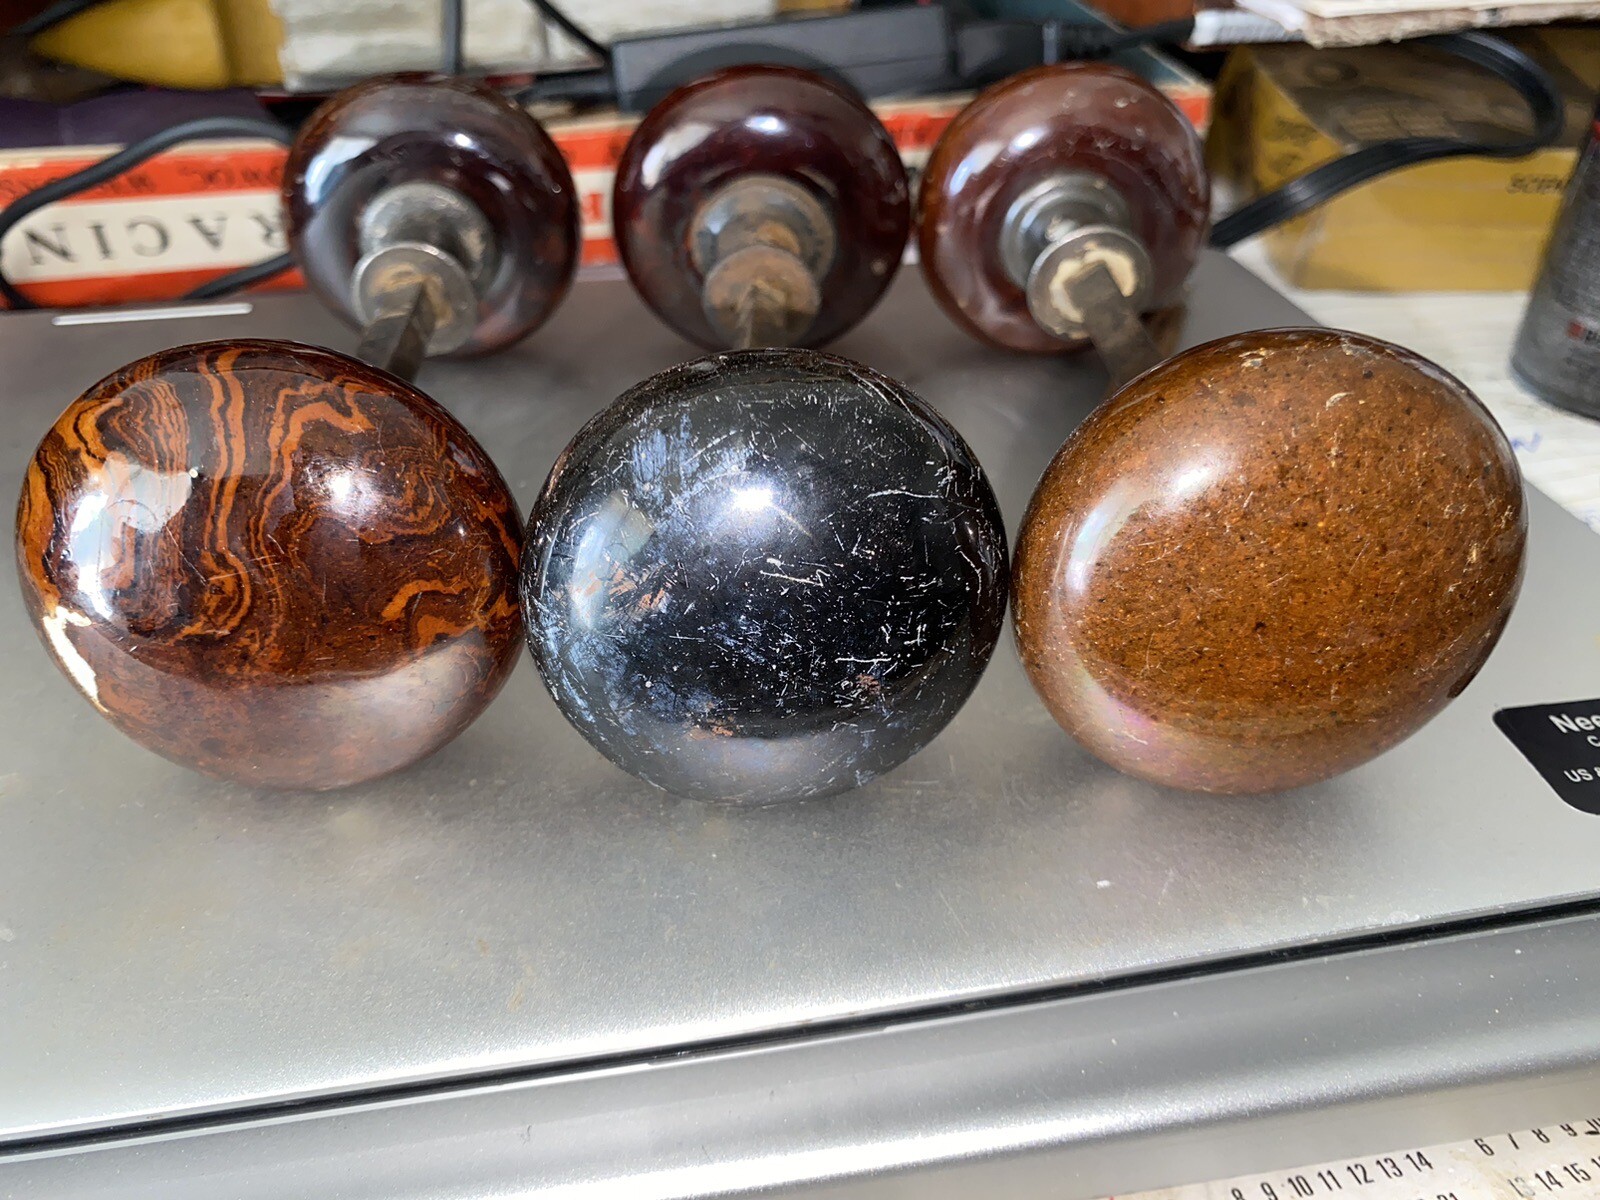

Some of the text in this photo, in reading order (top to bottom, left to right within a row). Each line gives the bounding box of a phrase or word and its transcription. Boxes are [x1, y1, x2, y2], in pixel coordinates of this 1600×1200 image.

[1563, 768, 1594, 782] US
[1287, 1175, 1315, 1198] 10
[1317, 1169, 1343, 1192] 11
[1346, 1163, 1375, 1186] 12
[1376, 1157, 1403, 1180] 13
[1405, 1151, 1434, 1172] 14
[1534, 1170, 1564, 1191] 14
[1563, 1162, 1592, 1184] 15
